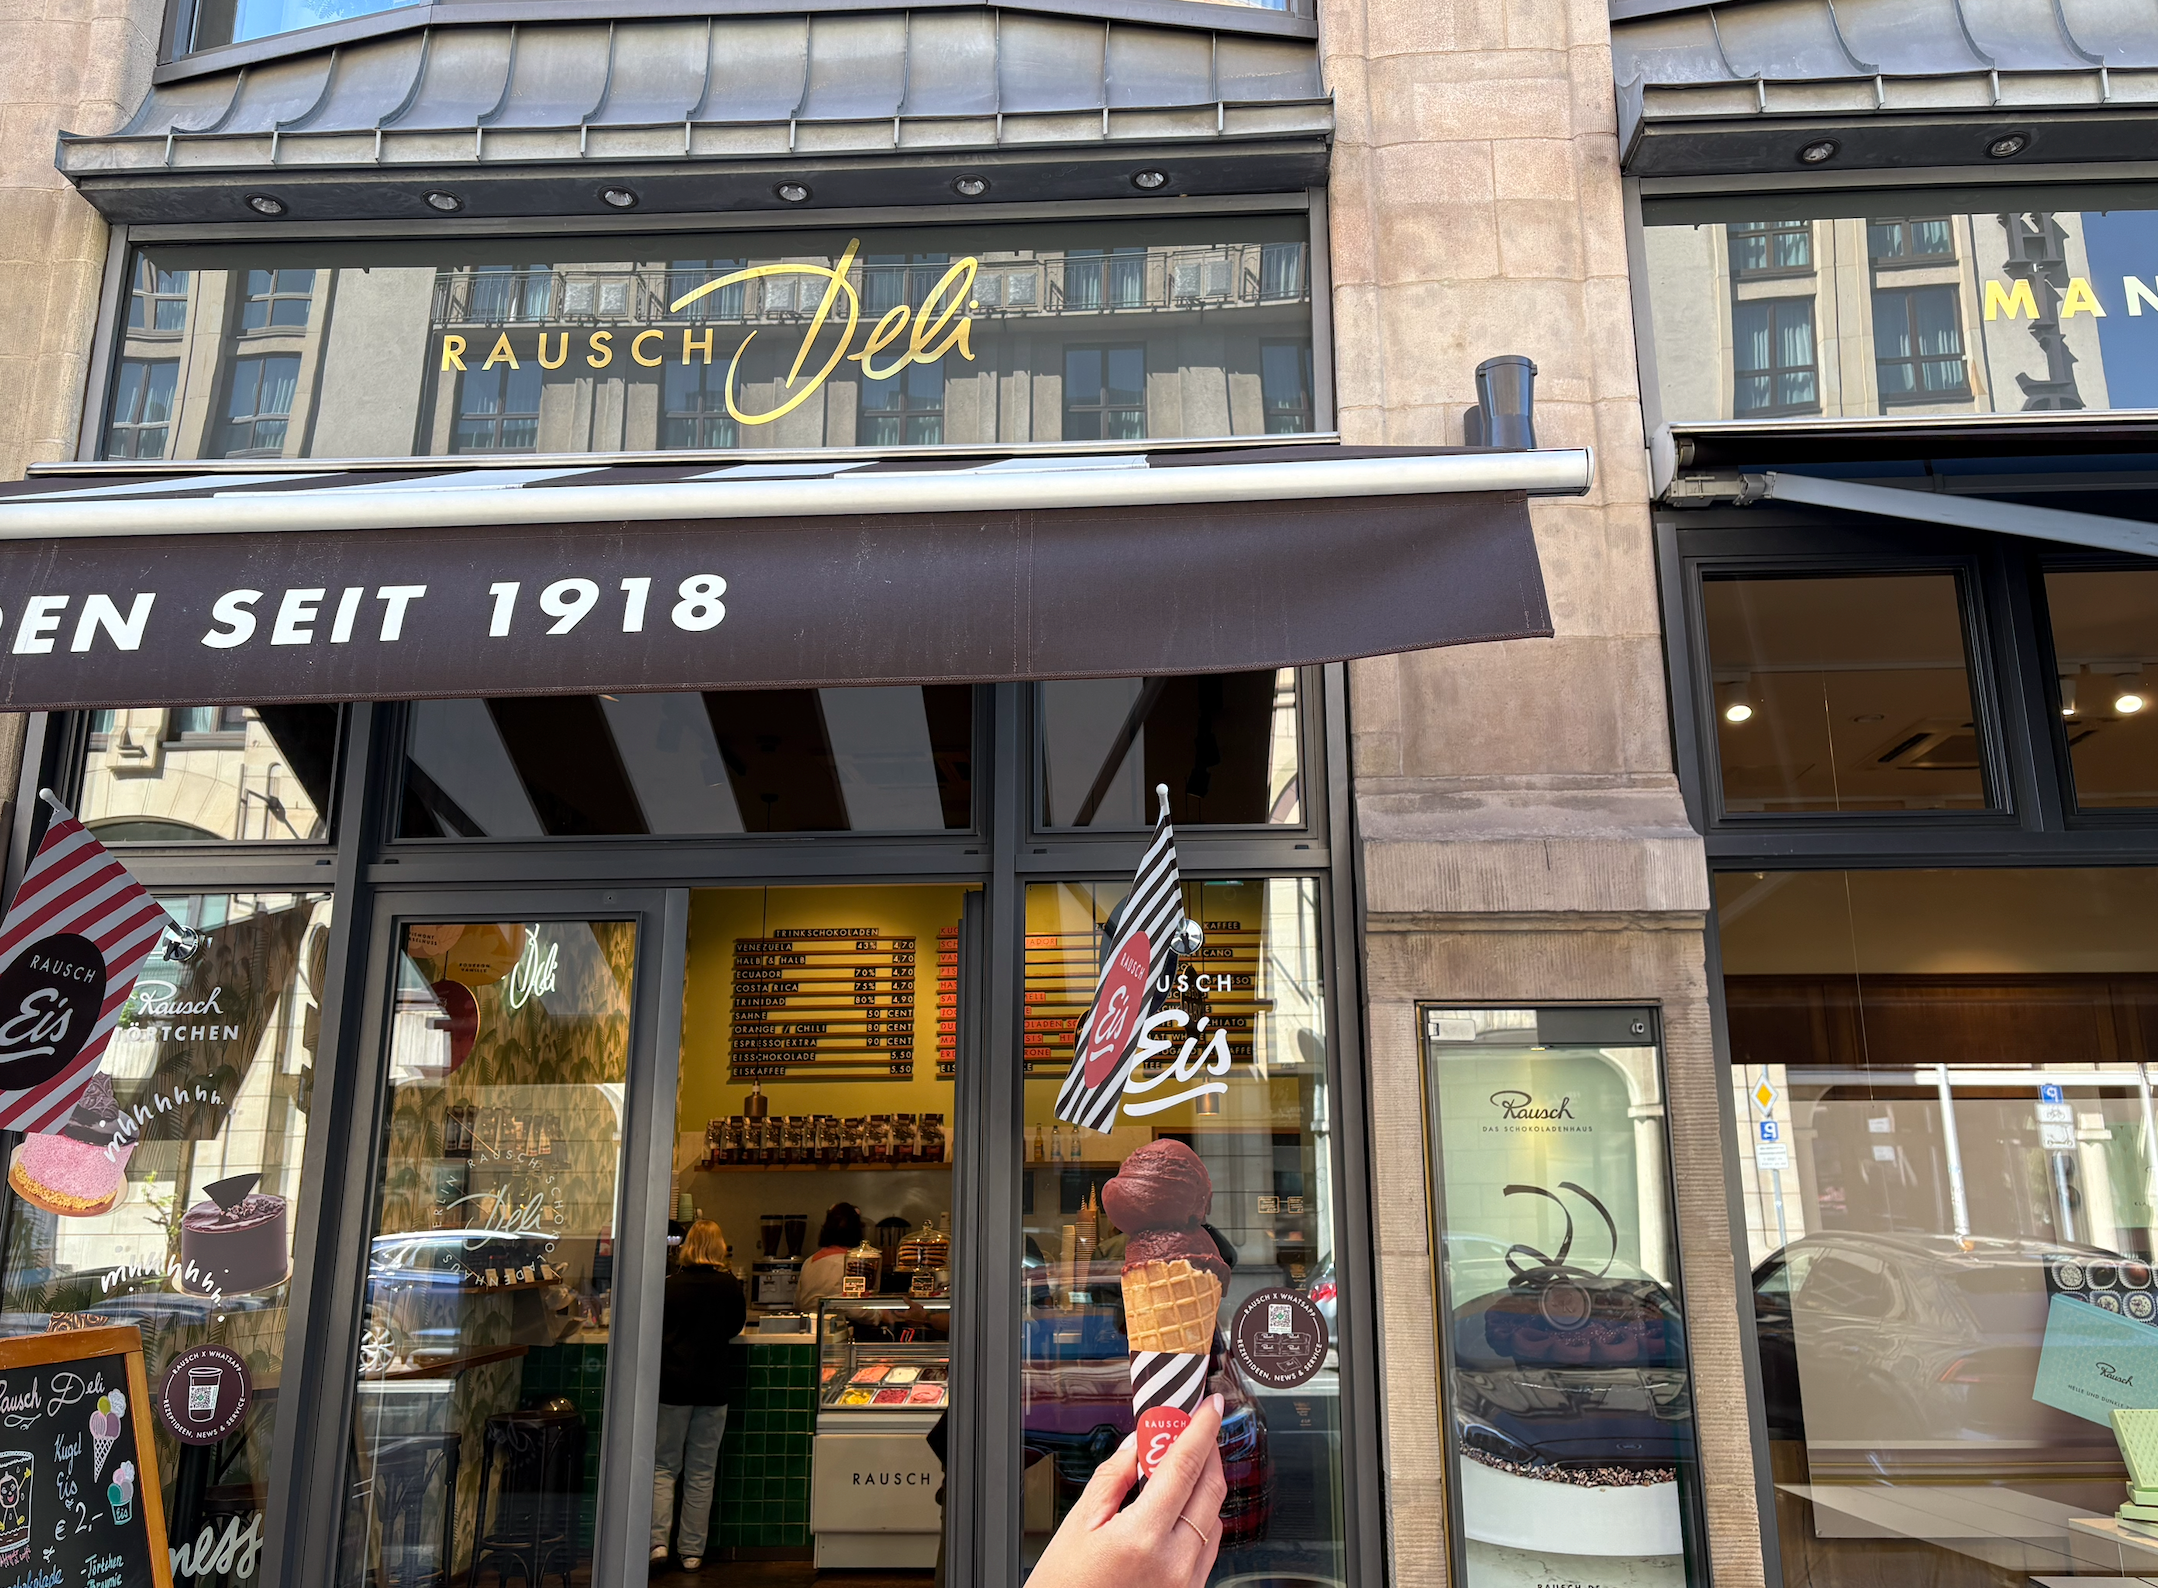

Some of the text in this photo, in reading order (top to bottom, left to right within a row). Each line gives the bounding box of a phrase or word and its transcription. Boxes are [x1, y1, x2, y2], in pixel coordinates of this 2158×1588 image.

[440, 237, 980, 425] RAUSCH Deli
[0, 573, 728, 655] EN SEIT 1918
[775, 928, 879, 938] TRINKSCHOKOLADEN
[1204, 921, 1239, 930] KAFFEE
[736, 941, 914, 952] VENEZUELA 43% 4,70
[29, 954, 97, 984] RAUSCH
[736, 955, 914, 965] HALB & HALB 4,70
[1120, 952, 1147, 981] RAUSCH
[736, 968, 914, 979] ECUADOR 70% 4,70
[1156, 974, 1232, 993] USCH
[133, 980, 224, 1015] Rausch
[735, 982, 914, 993] COSTA RICA 75% 4,70
[735, 995, 913, 1006] TRINIDAD 80% 4,90
[0, 987, 74, 1047] Eis
[735, 1009, 913, 1020] SAHNE 50 CENT
[1095, 985, 1130, 1045] Eis
[734, 1025, 775, 1034] ORANGE
[795, 1024, 827, 1033] CHILI
[866, 1023, 880, 1031] 80
[887, 1023, 913, 1031] CENT
[733, 1037, 913, 1048] ESPRESSO EXTRA 90 CENT
[1123, 1009, 1232, 1093] Eis
[732, 1051, 912, 1062] EISSCHOKOLADE 5,50
[732, 1065, 912, 1076] EISKAFFEE 5,50
[1490, 1090, 1575, 1120] Rausch
[467, 1150, 538, 1169] RAUSCH
[432, 1175, 458, 1228] ERLIN
[446, 1184, 545, 1251] Deli
[1244, 1293, 1270, 1315] RAUSCH
[1280, 1293, 1316, 1317] WHATSAPP
[172, 1353, 199, 1375] RAUSCH
[209, 1351, 242, 1372] WHATSAPP
[1236, 1339, 1271, 1381] REZEPTIDEEN,
[1274, 1372, 1297, 1382] NEWS
[1303, 1343, 1322, 1372] SERVICE
[2095, 1361, 2134, 1388] Rausch
[47, 1371, 106, 1418] Deli
[163, 1399, 194, 1438] REZEPTIDEEN,
[196, 1428, 218, 1438] NEWS
[225, 1398, 246, 1426] SERVICE
[1144, 1420, 1187, 1429] RAUSCH
[54, 1431, 83, 1469] Kugel
[56, 1470, 79, 1500] Eis
[853, 1472, 931, 1486] RAUSCH
[115, 1506, 129, 1521] Eis
[55, 1519, 68, 1542] €
